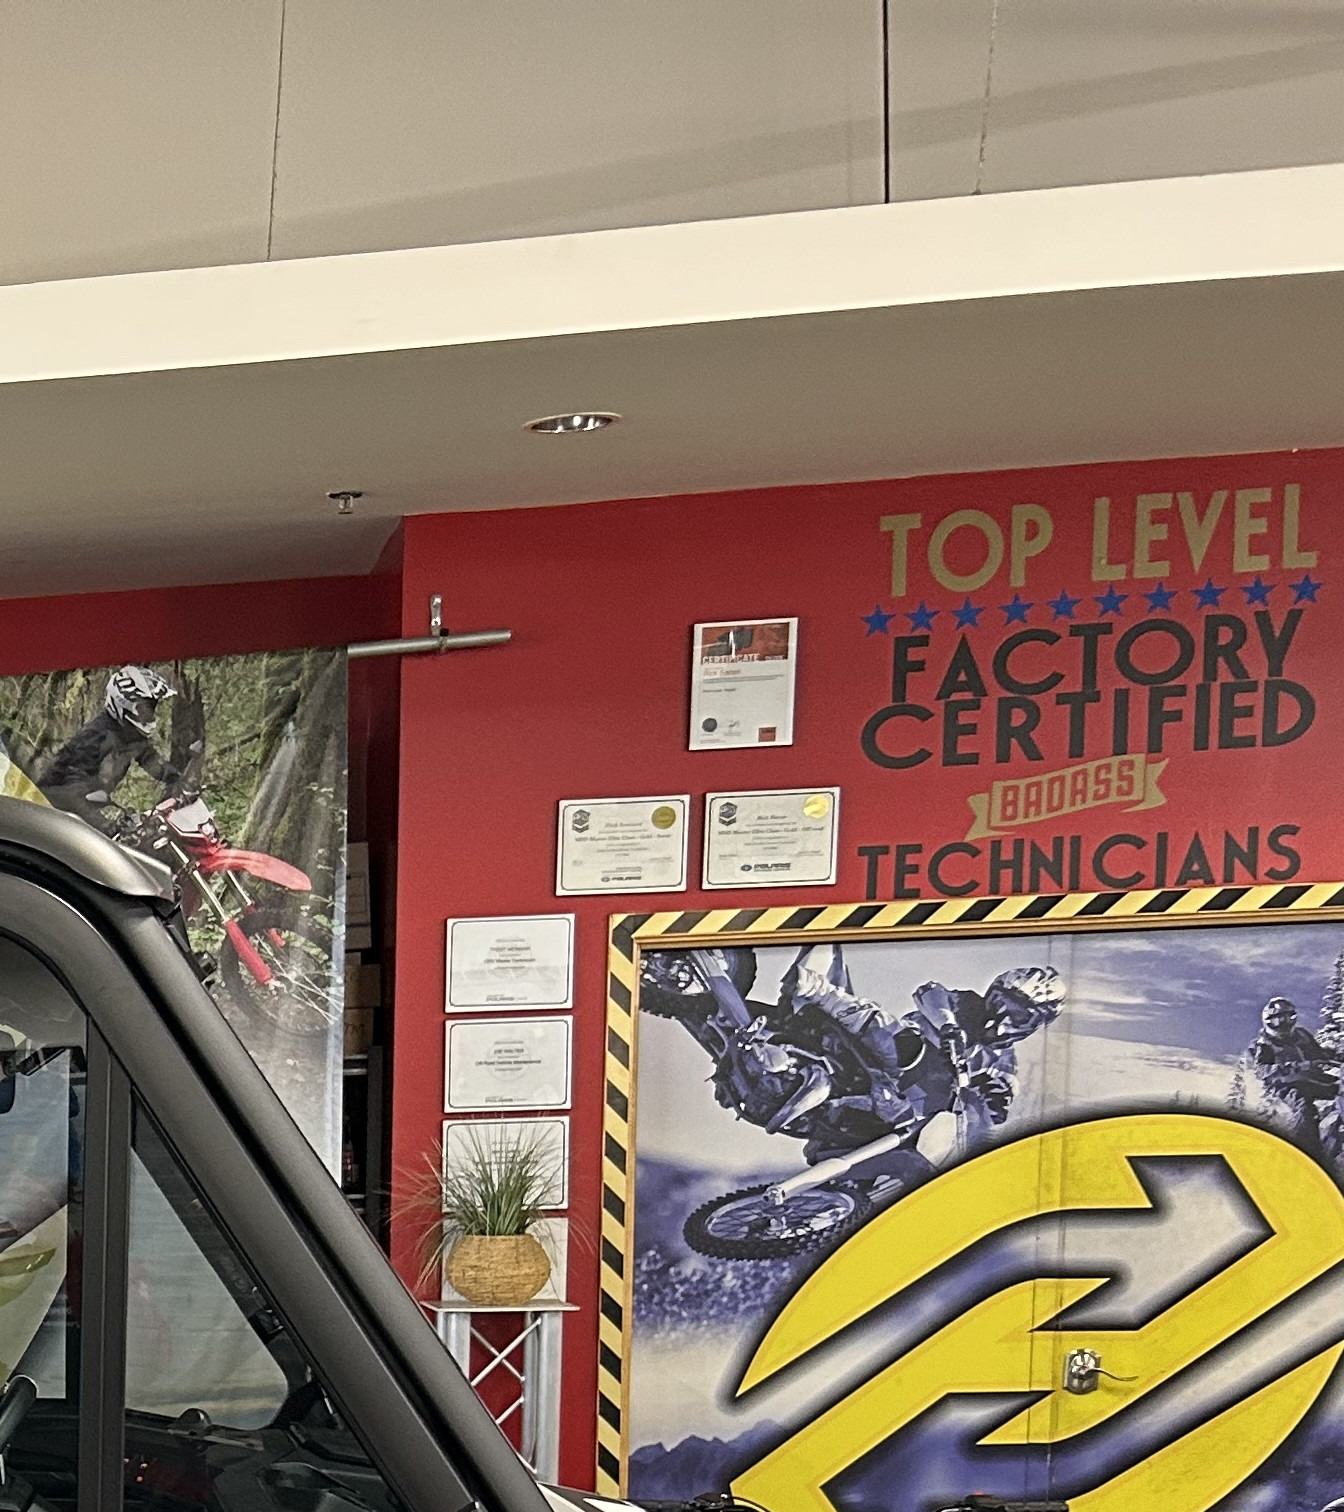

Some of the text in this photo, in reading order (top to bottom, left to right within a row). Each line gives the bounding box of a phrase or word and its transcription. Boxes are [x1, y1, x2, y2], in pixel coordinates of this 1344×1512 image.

[879, 483, 1318, 598] TOP LEVEL
[891, 608, 1303, 704] FACTORY
[860, 679, 1317, 770] CERTIFIED
[1000, 758, 1136, 825] BADASS
[857, 823, 1302, 900] TECHNICIANS
